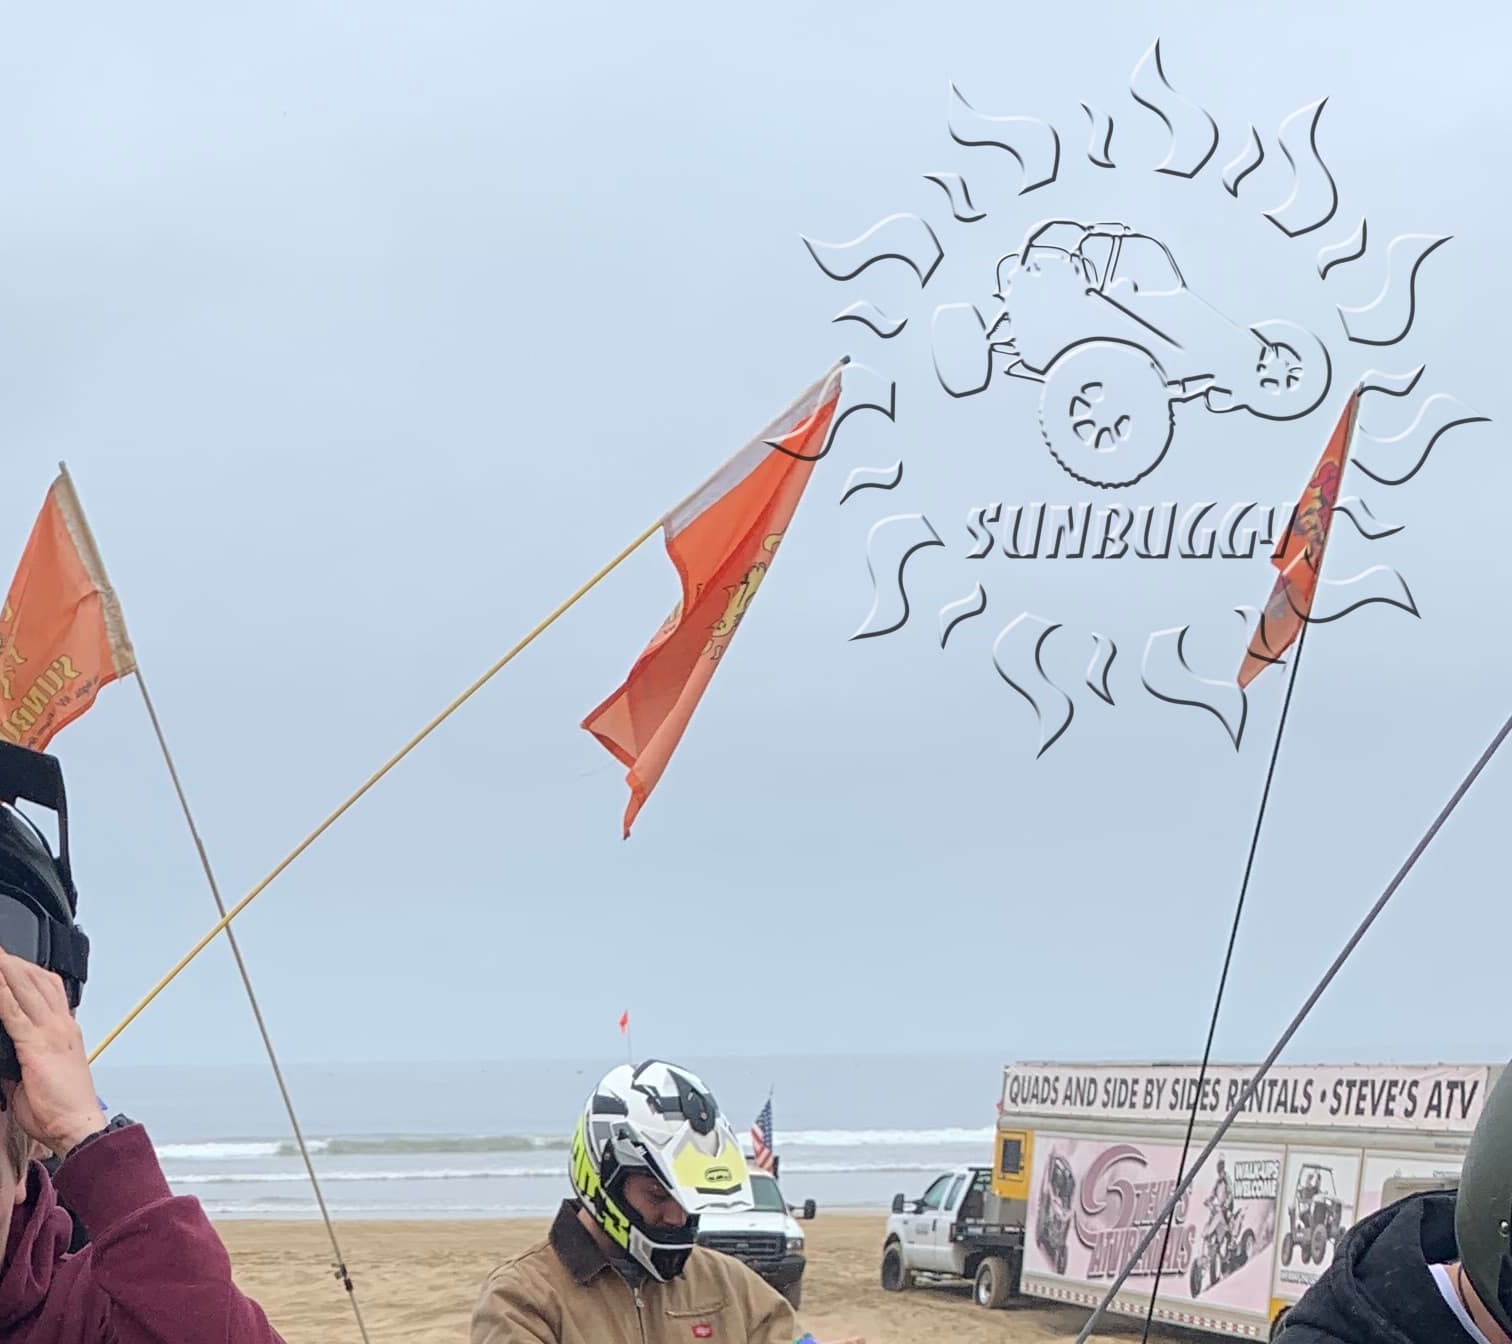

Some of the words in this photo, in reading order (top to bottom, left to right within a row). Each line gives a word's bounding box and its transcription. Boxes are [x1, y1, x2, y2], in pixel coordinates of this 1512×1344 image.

[1009, 1074, 1060, 1106] QUADS
[1062, 1076, 1098, 1107] AND
[1101, 1077, 1140, 1109] SIDE
[1143, 1078, 1167, 1110] BY
[1169, 1077, 1221, 1111] SIDES
[1225, 1078, 1314, 1114] RENTALS
[1329, 1078, 1419, 1118] STEVE'S
[1424, 1080, 1479, 1119] ATV
